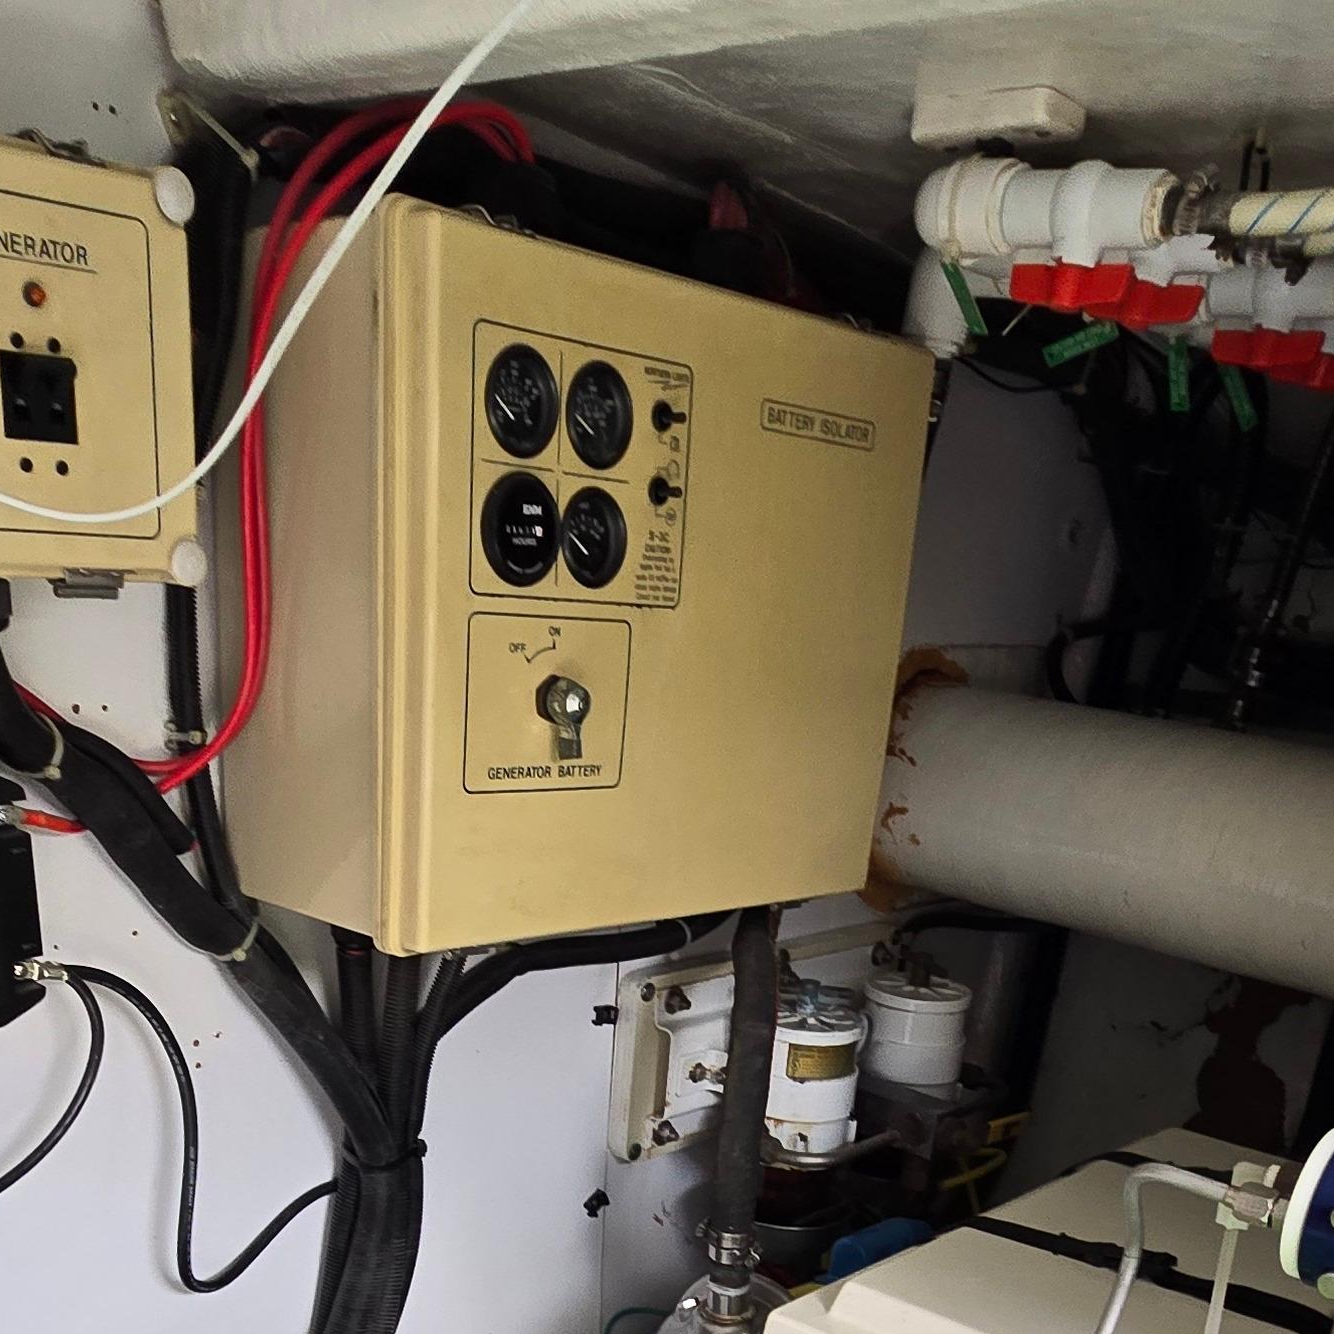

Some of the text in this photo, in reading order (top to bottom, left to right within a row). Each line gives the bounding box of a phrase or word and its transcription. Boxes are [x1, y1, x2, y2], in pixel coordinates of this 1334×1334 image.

[767, 406, 870, 443] BATTERY ISOLATOR
[548, 625, 562, 638] ON
[508, 642, 528, 655] OFF
[487, 764, 603, 780] GENERATOR BATTERY
